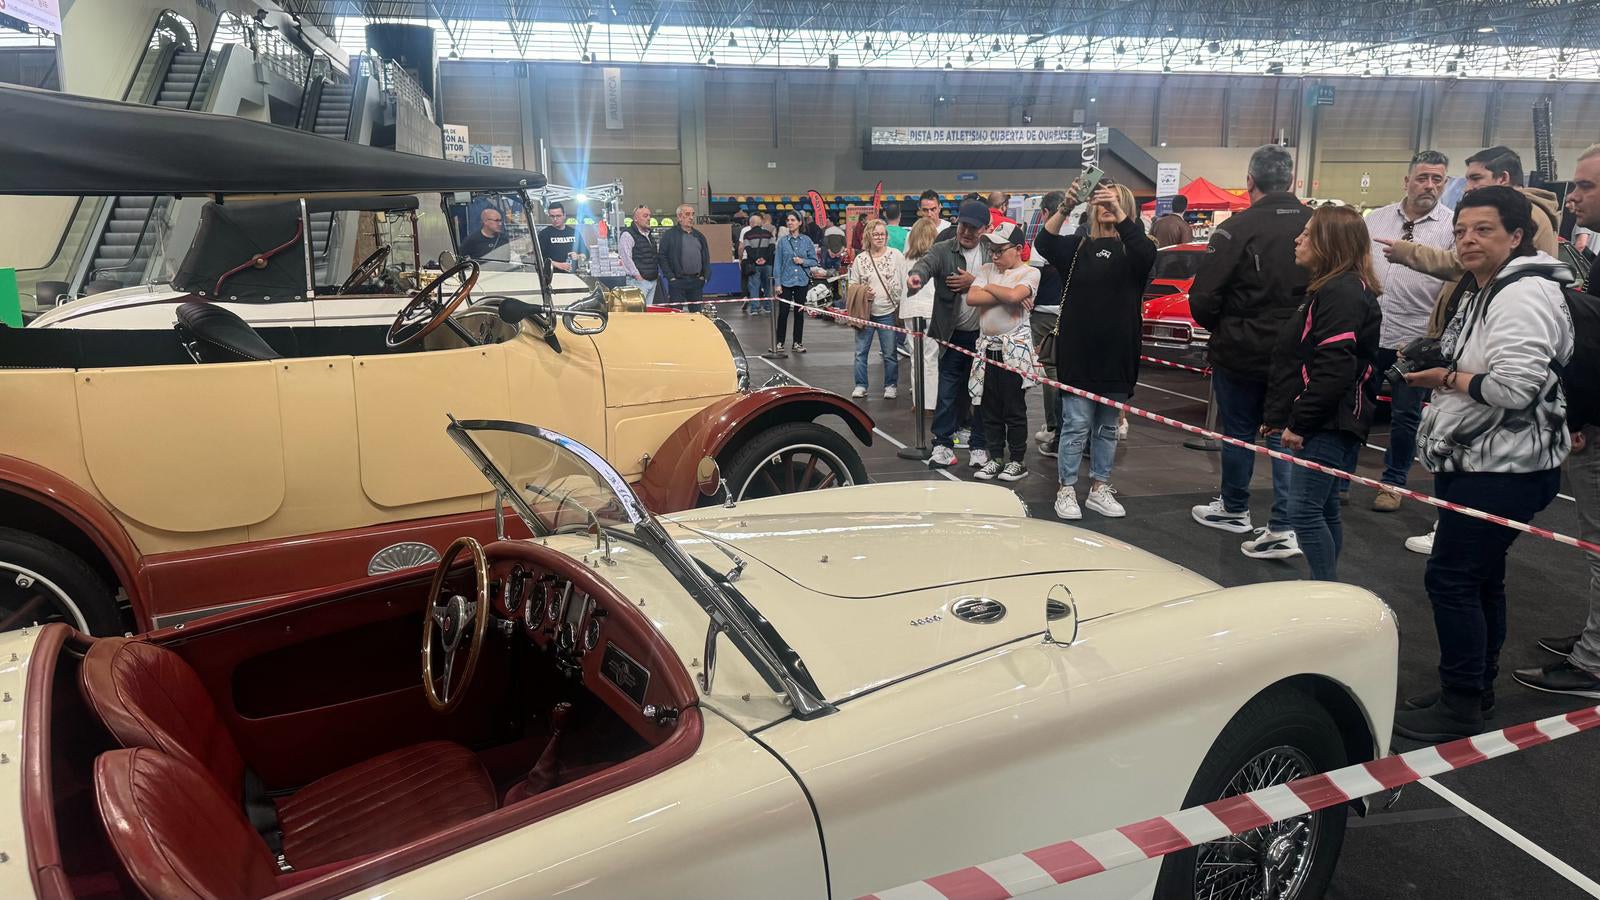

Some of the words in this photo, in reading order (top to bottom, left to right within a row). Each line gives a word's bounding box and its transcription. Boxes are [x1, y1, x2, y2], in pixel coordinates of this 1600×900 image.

[910, 130, 931, 141] PISTA
[934, 130, 944, 141] DE
[946, 130, 988, 141] ATLETISMO
[990, 130, 1024, 140] CUBERTA
[1026, 130, 1036, 140] DE
[1038, 130, 1072, 140] OURENSE
